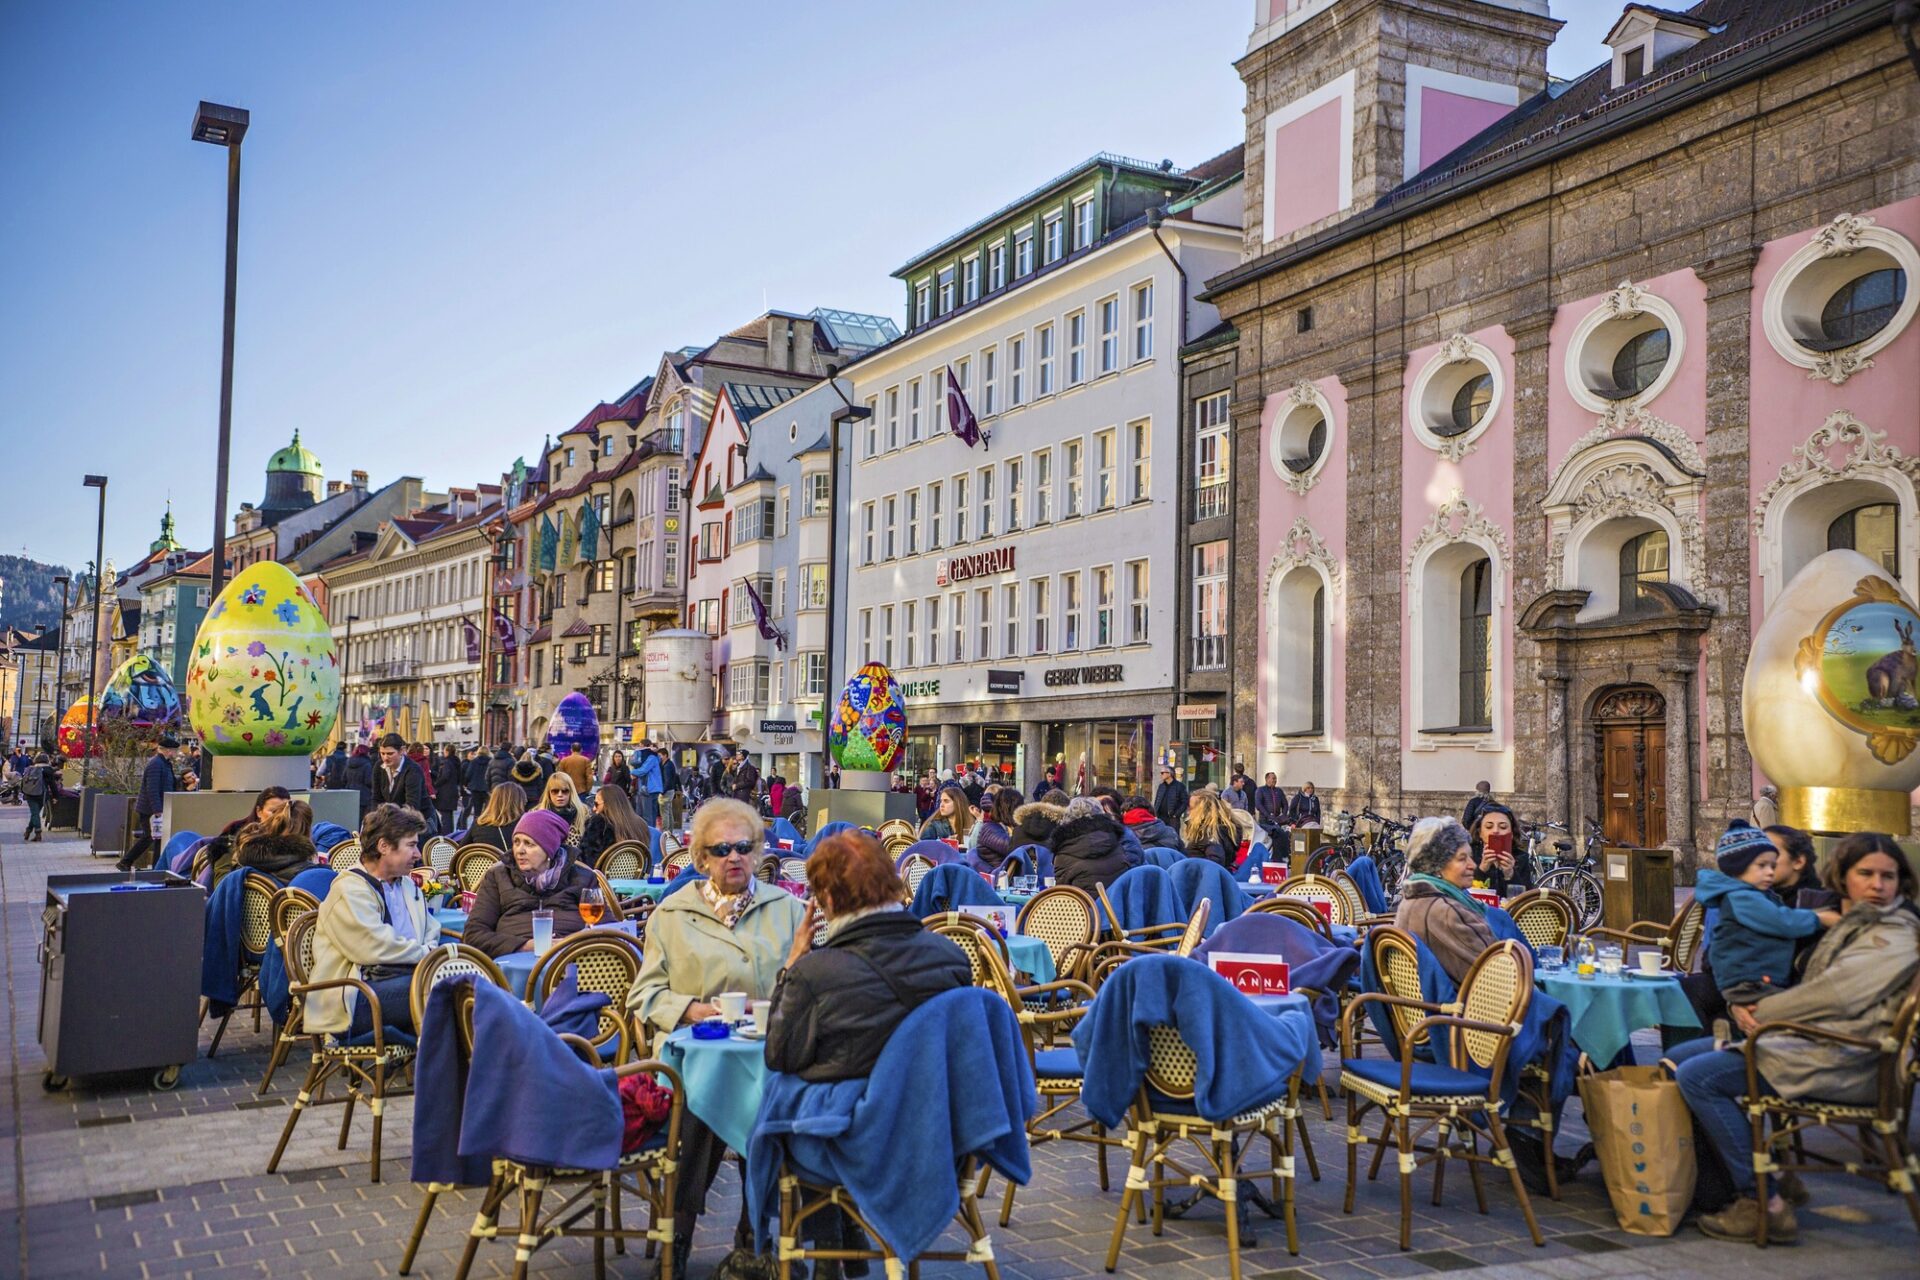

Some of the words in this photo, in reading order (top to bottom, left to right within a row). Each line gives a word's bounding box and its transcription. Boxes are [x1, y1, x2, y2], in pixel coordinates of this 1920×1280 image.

[949, 546, 1016, 583] GENERALI
[1044, 667, 1081, 687] GERRY
[1081, 664, 1124, 684] WEBER
[900, 679, 940, 697] OTHEKE
